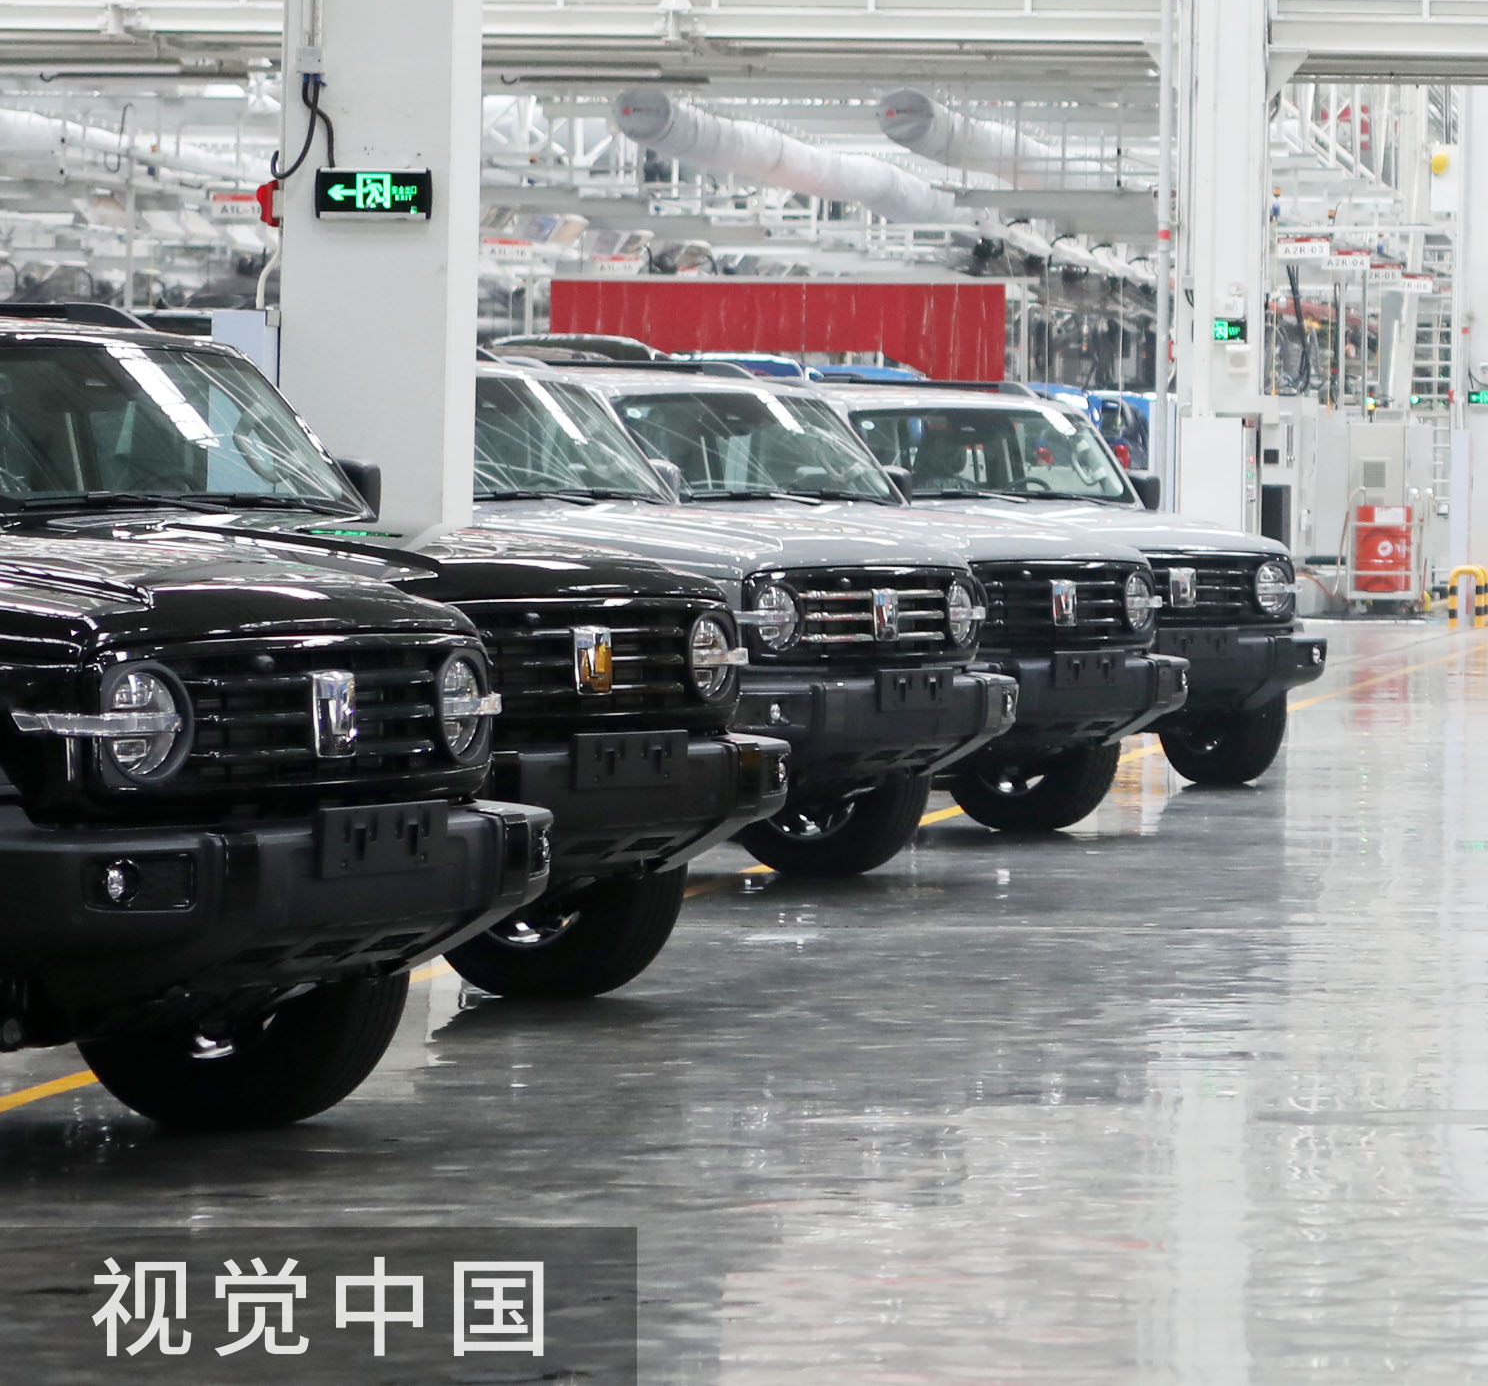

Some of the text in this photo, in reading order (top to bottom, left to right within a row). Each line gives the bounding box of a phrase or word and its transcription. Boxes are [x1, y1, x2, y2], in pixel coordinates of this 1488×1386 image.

[1283, 242, 1325, 255] A2R-03
[1326, 256, 1365, 267] A2R-04
[1363, 270, 1398, 280] 2R-05
